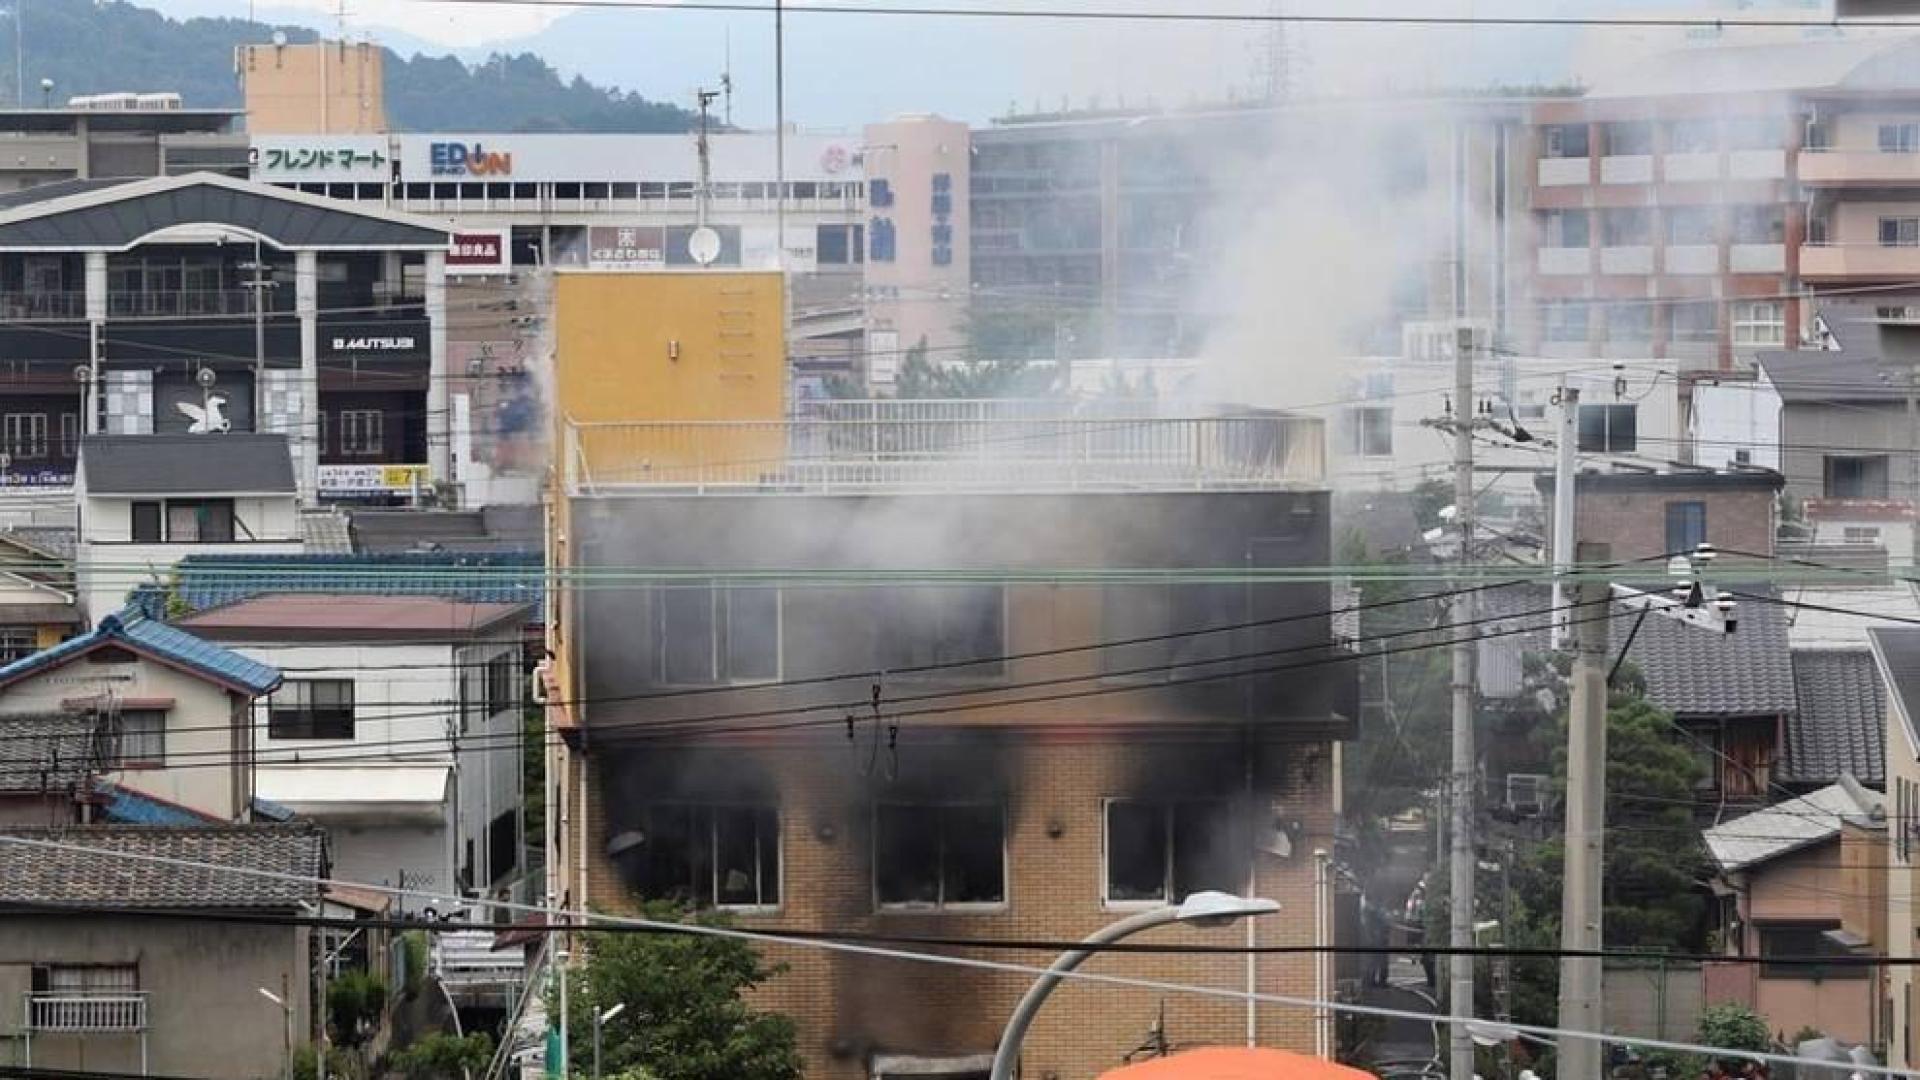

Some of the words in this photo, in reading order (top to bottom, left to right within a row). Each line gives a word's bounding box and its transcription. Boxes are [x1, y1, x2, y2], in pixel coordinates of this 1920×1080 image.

[266, 148, 385, 170] フレンドマート
[431, 143, 512, 176] EDION
